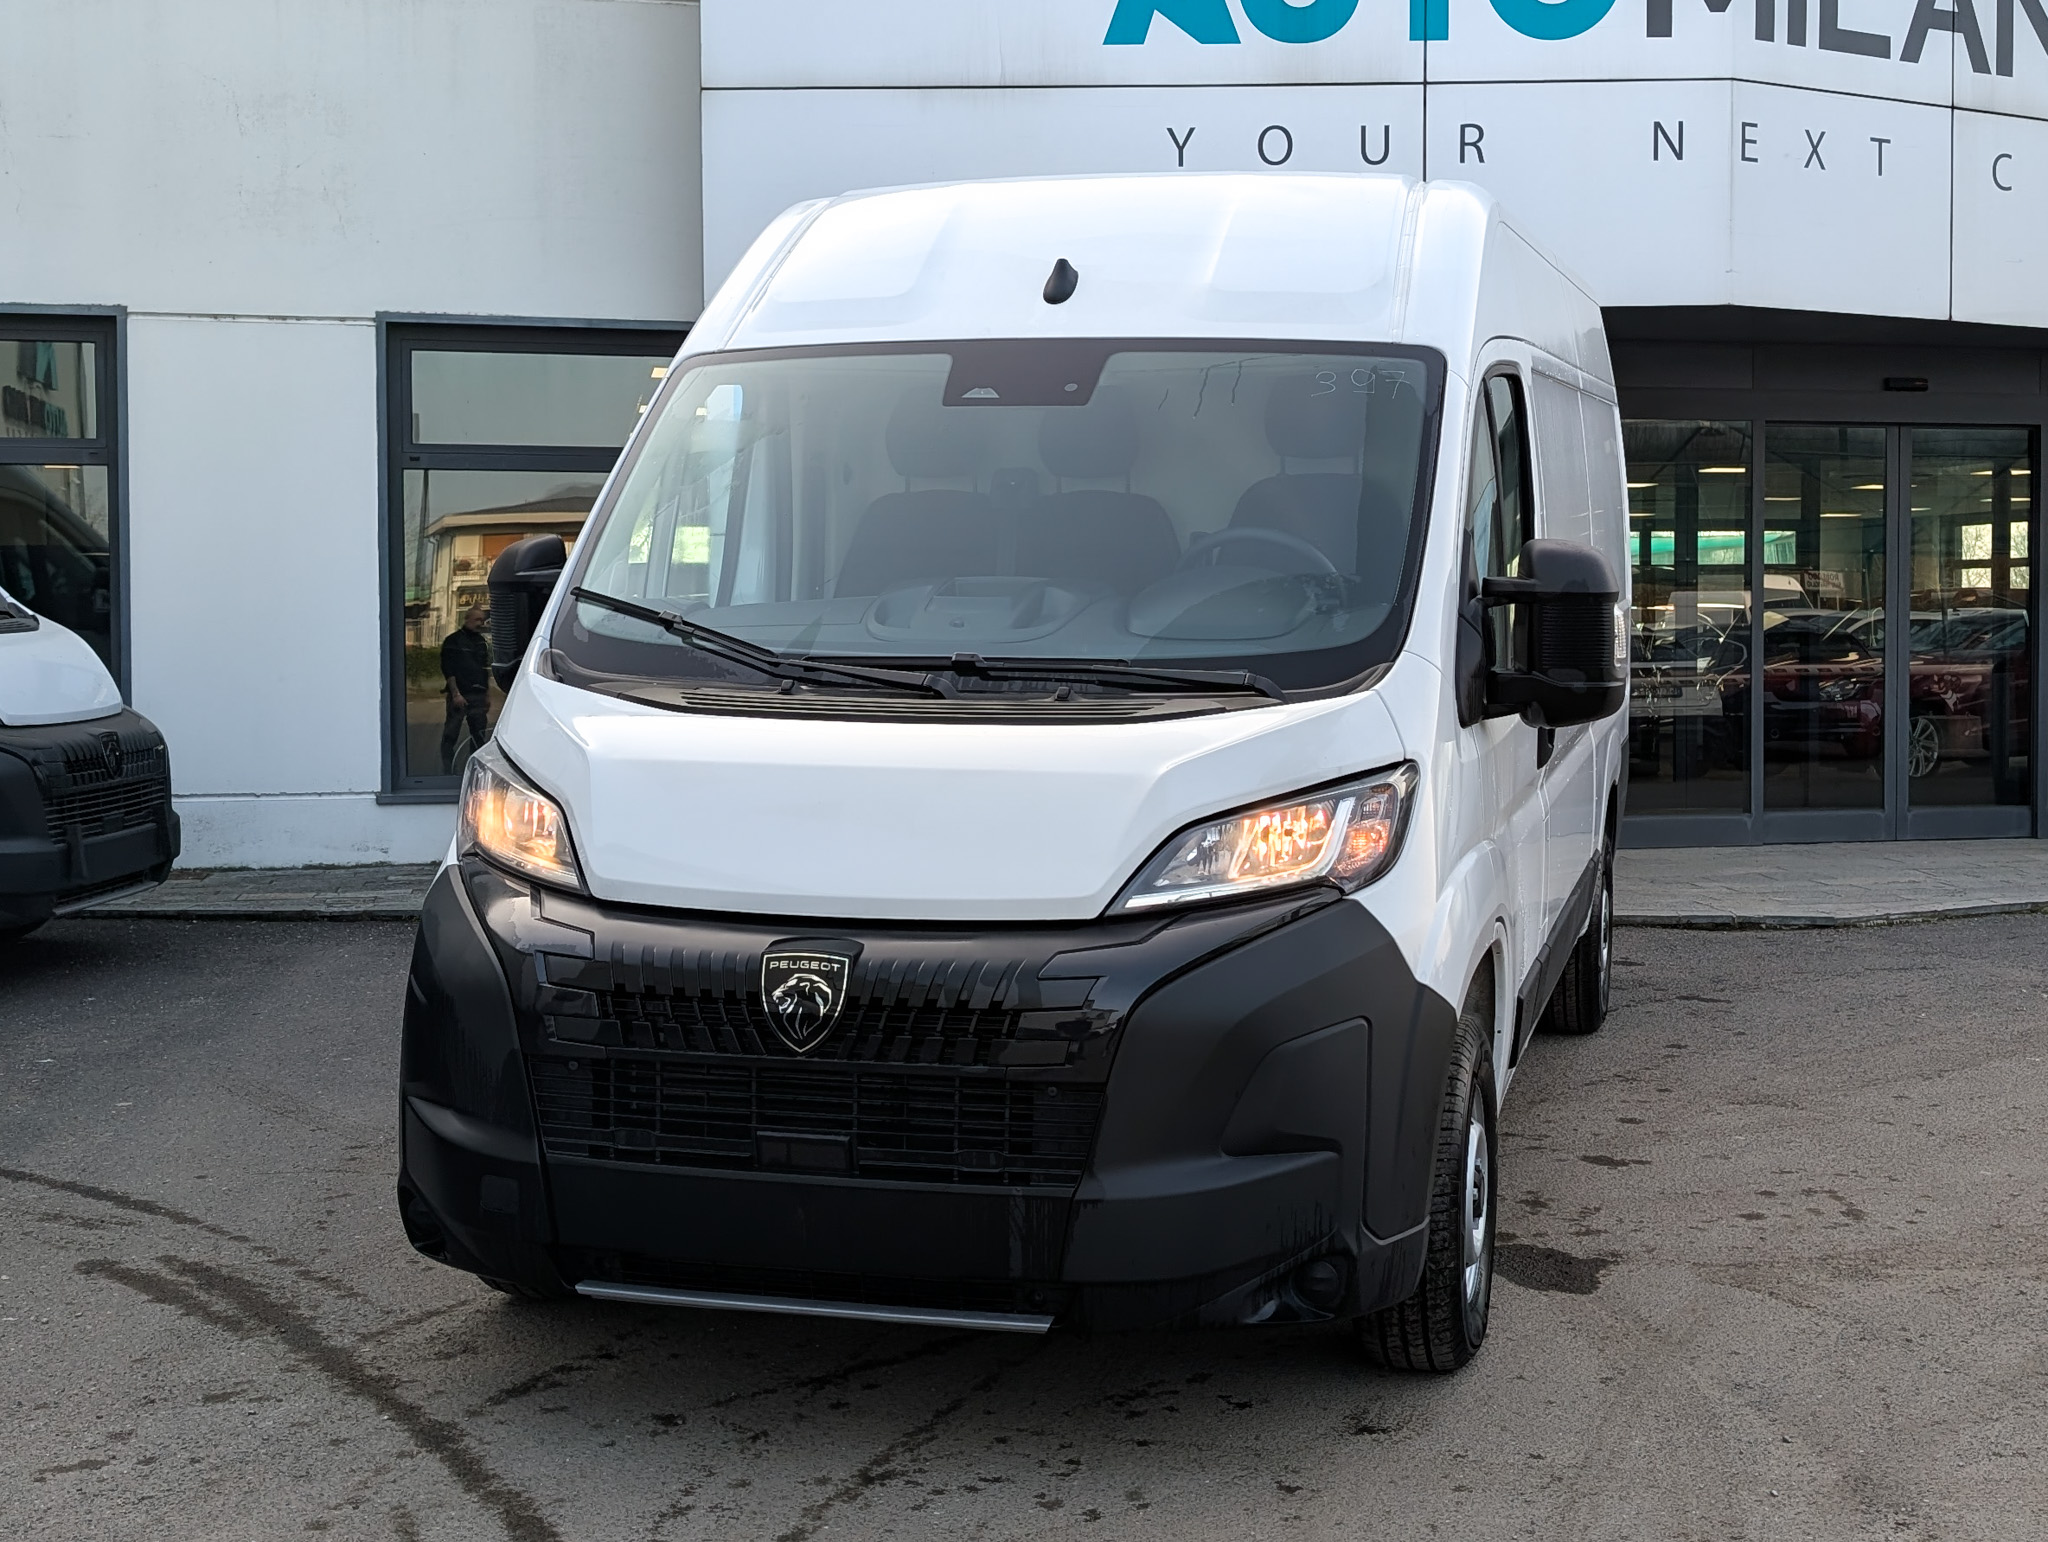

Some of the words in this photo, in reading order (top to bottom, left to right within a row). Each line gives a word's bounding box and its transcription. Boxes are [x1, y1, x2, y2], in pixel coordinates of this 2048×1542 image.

[1167, 123, 1487, 168] YOUR
[1652, 120, 1892, 177] NEXT
[1991, 152, 2013, 192] C
[1310, 367, 1411, 399] 397
[769, 960, 841, 972] PEUGEOT
